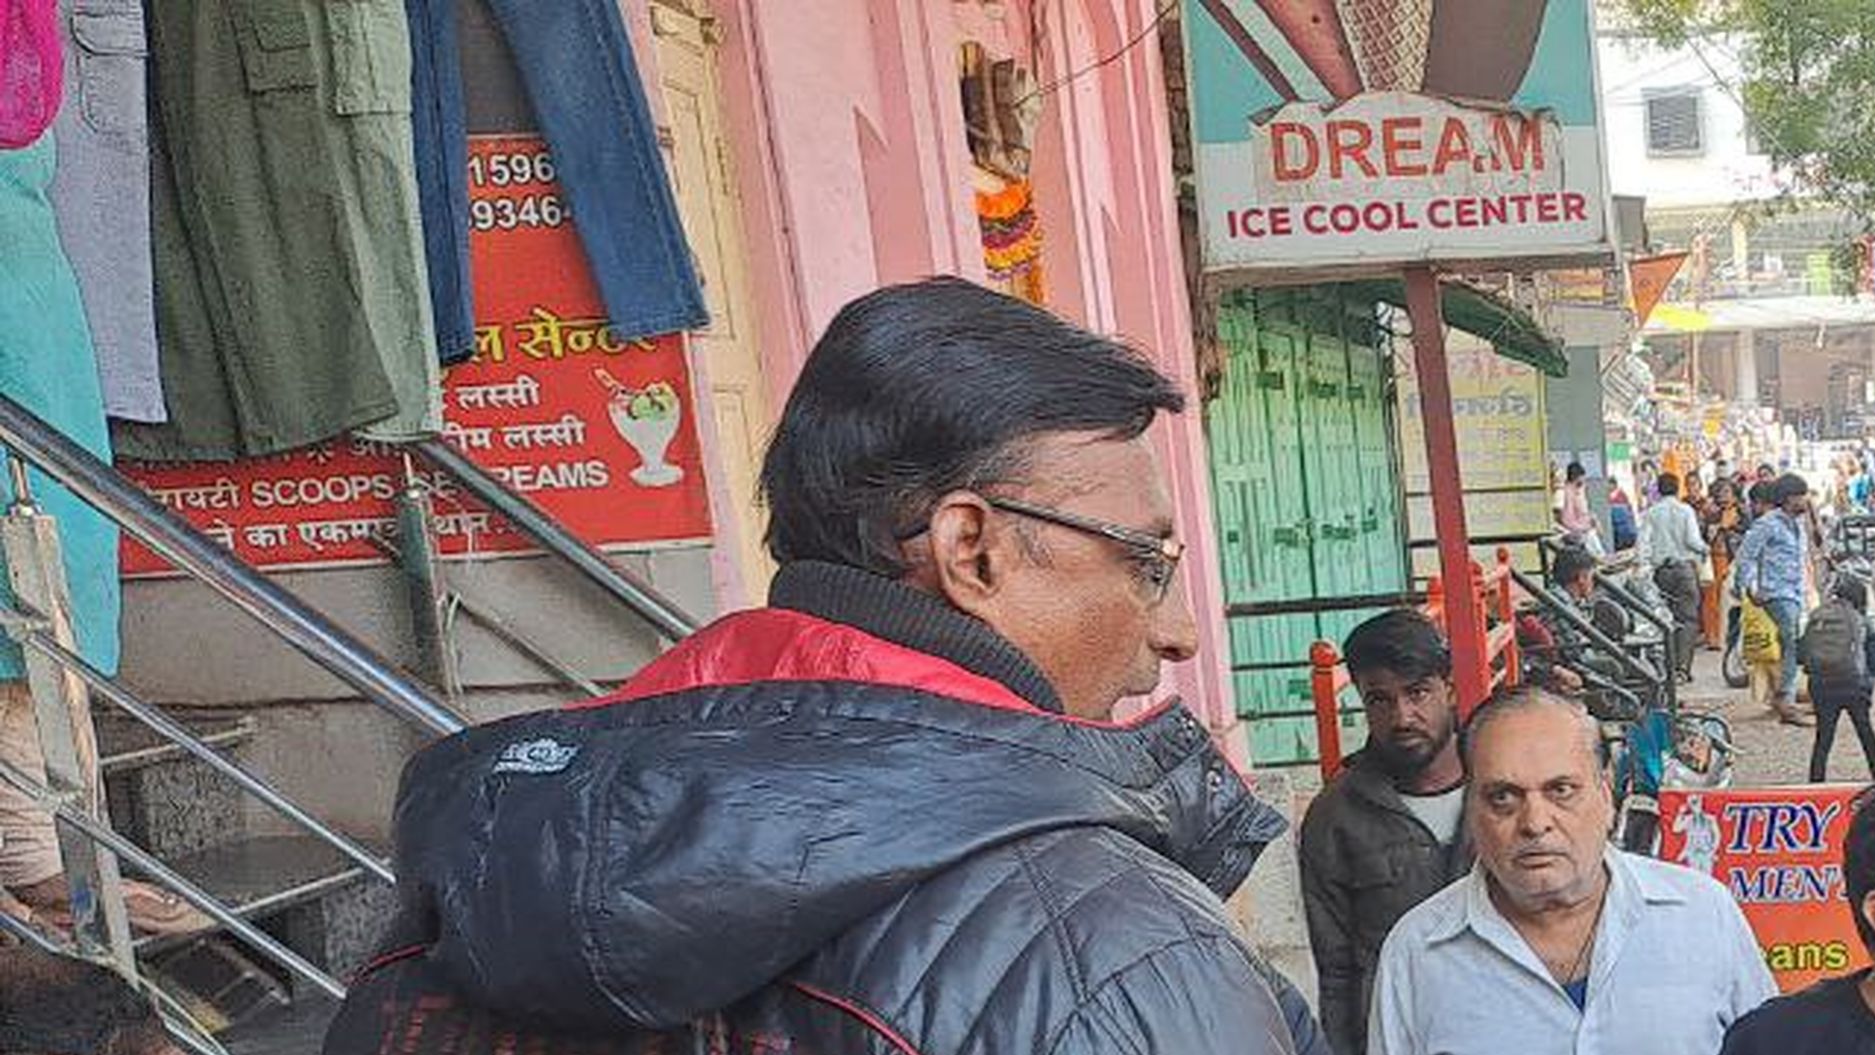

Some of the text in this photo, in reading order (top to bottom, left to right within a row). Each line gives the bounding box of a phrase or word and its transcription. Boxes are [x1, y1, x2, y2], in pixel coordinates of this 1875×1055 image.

[1269, 112, 1546, 183] DREAM
[467, 194, 572, 231] 9346
[1226, 193, 1589, 239] ICE COOL CENTER
[250, 475, 394, 507] SCOOPS
[244, 523, 288, 548] का
[1725, 802, 1842, 854] TRY
[1763, 940, 1849, 971] ans
